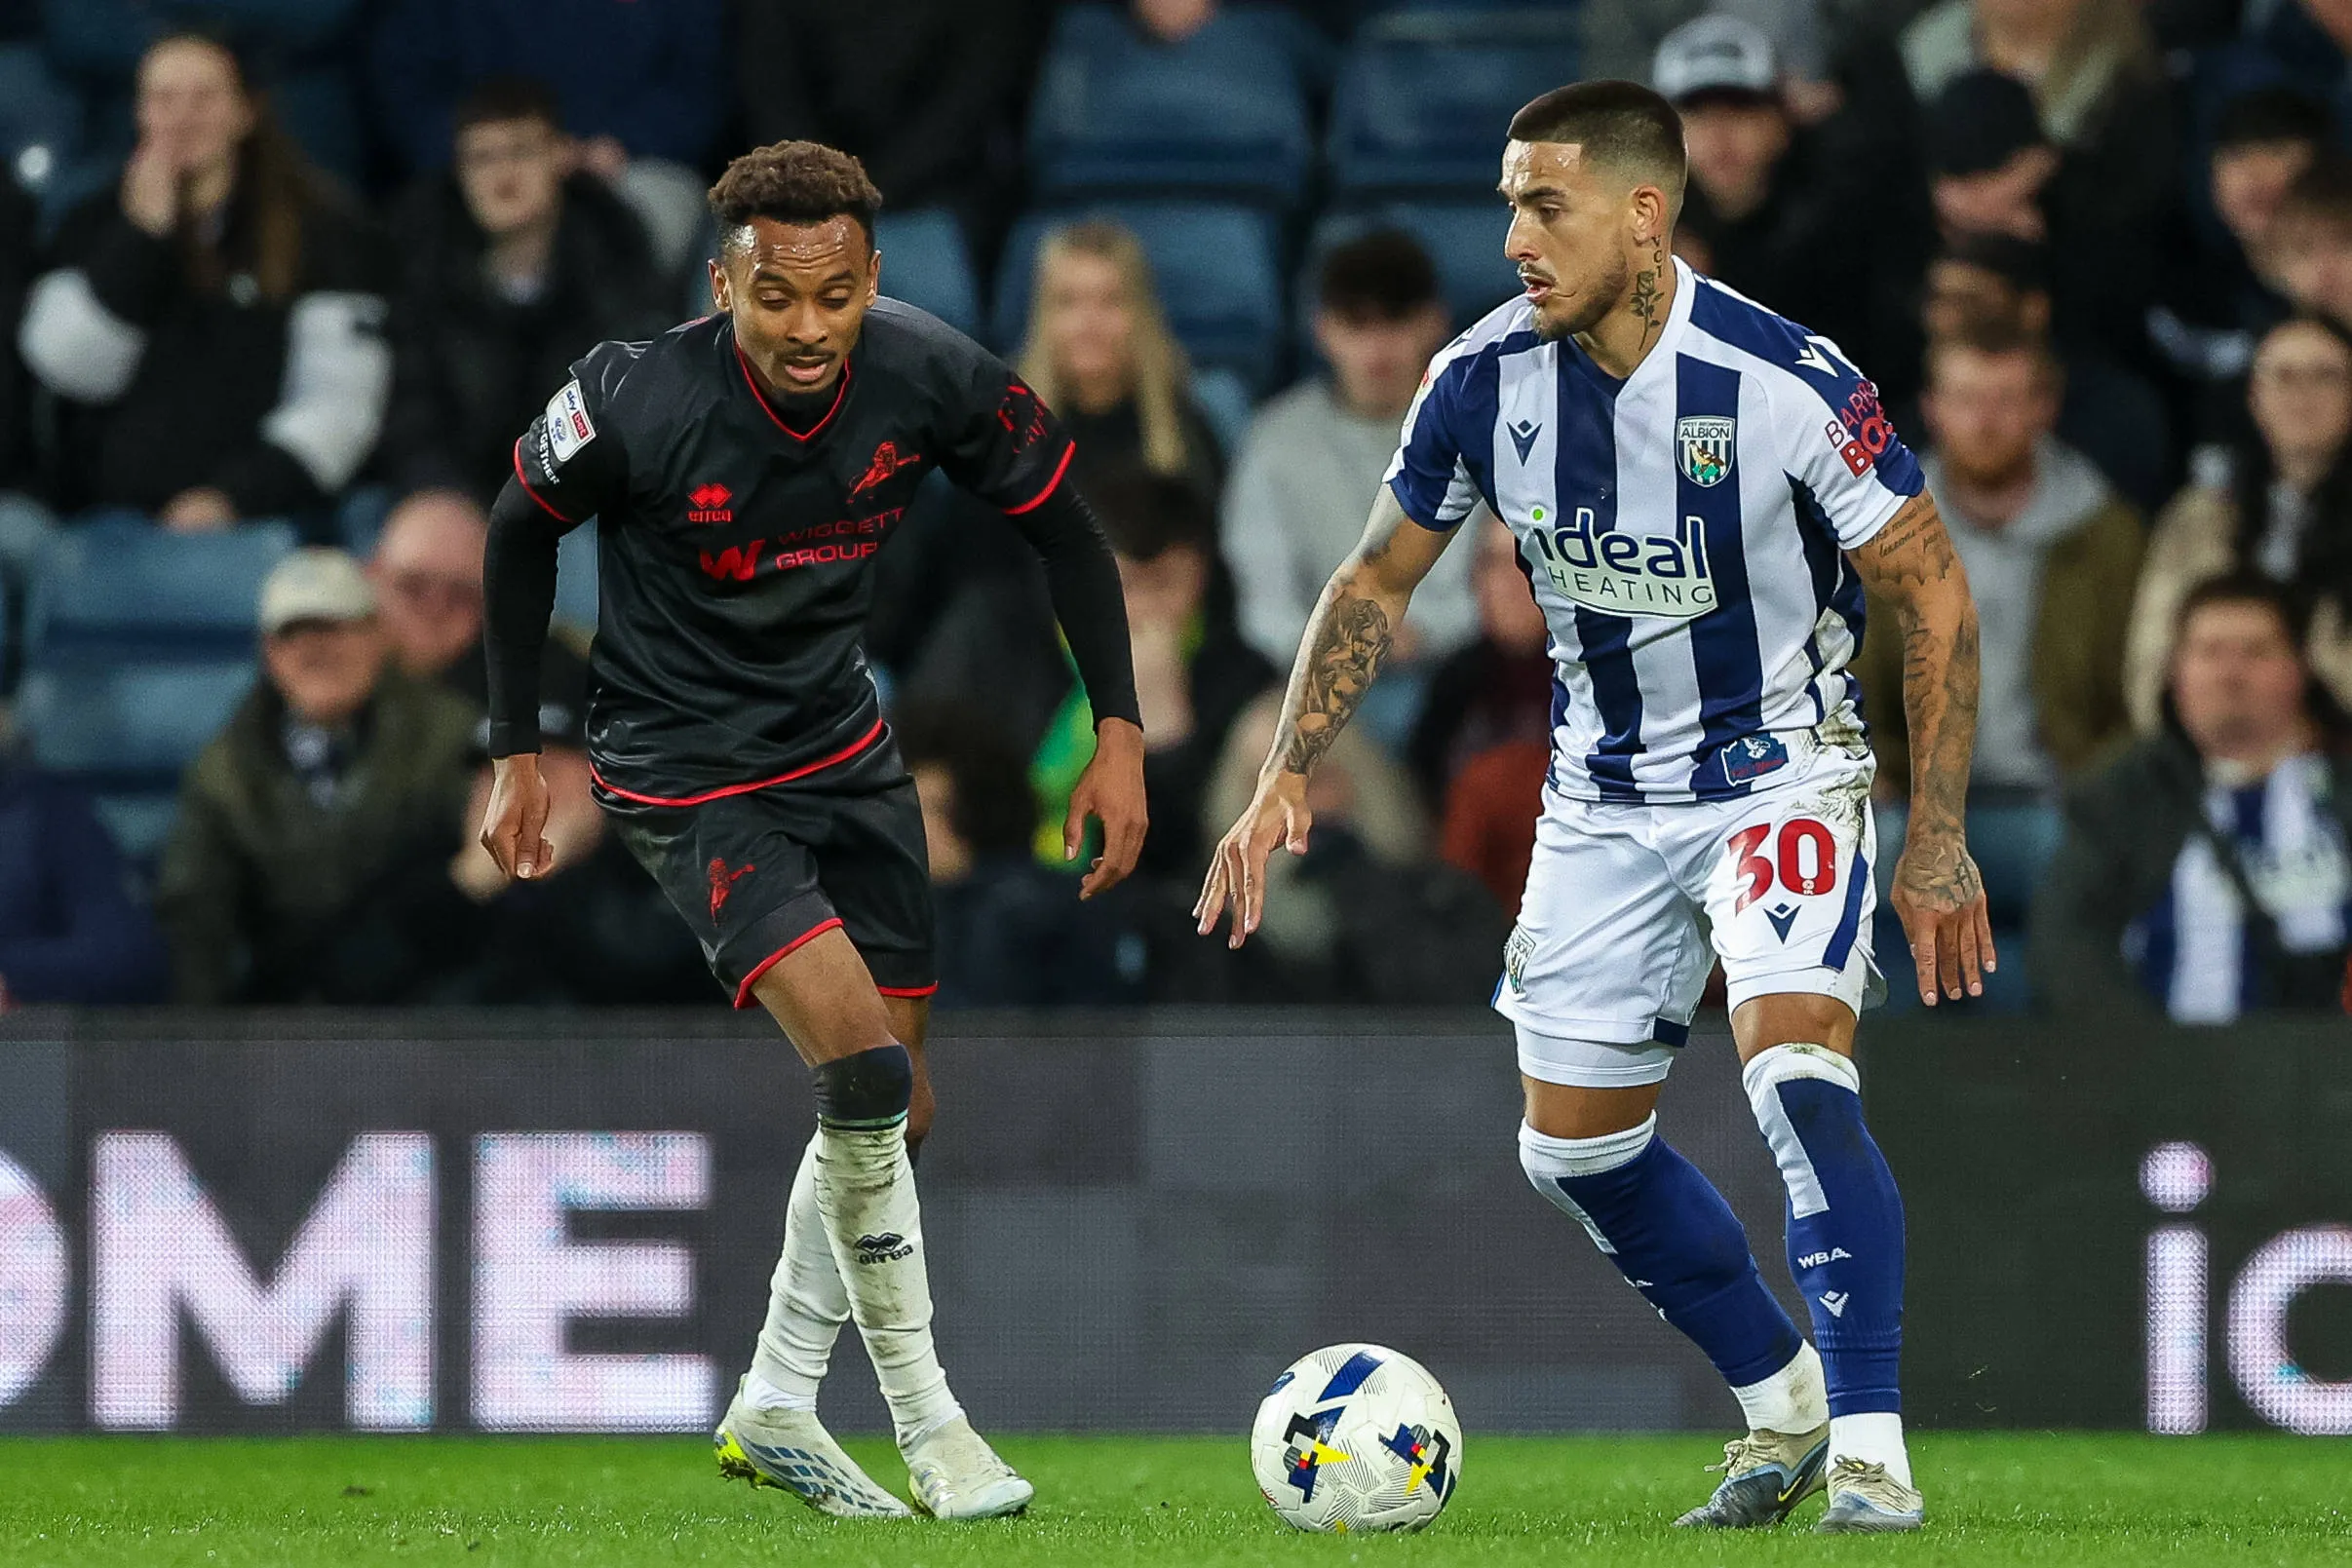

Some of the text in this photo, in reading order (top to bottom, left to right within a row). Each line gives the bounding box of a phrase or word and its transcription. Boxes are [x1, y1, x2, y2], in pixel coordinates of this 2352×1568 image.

[1680, 427, 1730, 439] ALBION
[1839, 401, 1894, 478] BO
[775, 541, 878, 570] GROUP
[1532, 510, 1708, 580] ideal
[1548, 565, 1713, 605] HEATING
[1727, 819, 1836, 918] 30
[0, 1130, 719, 1433] ME
[1797, 1247, 1852, 1269] WBA
